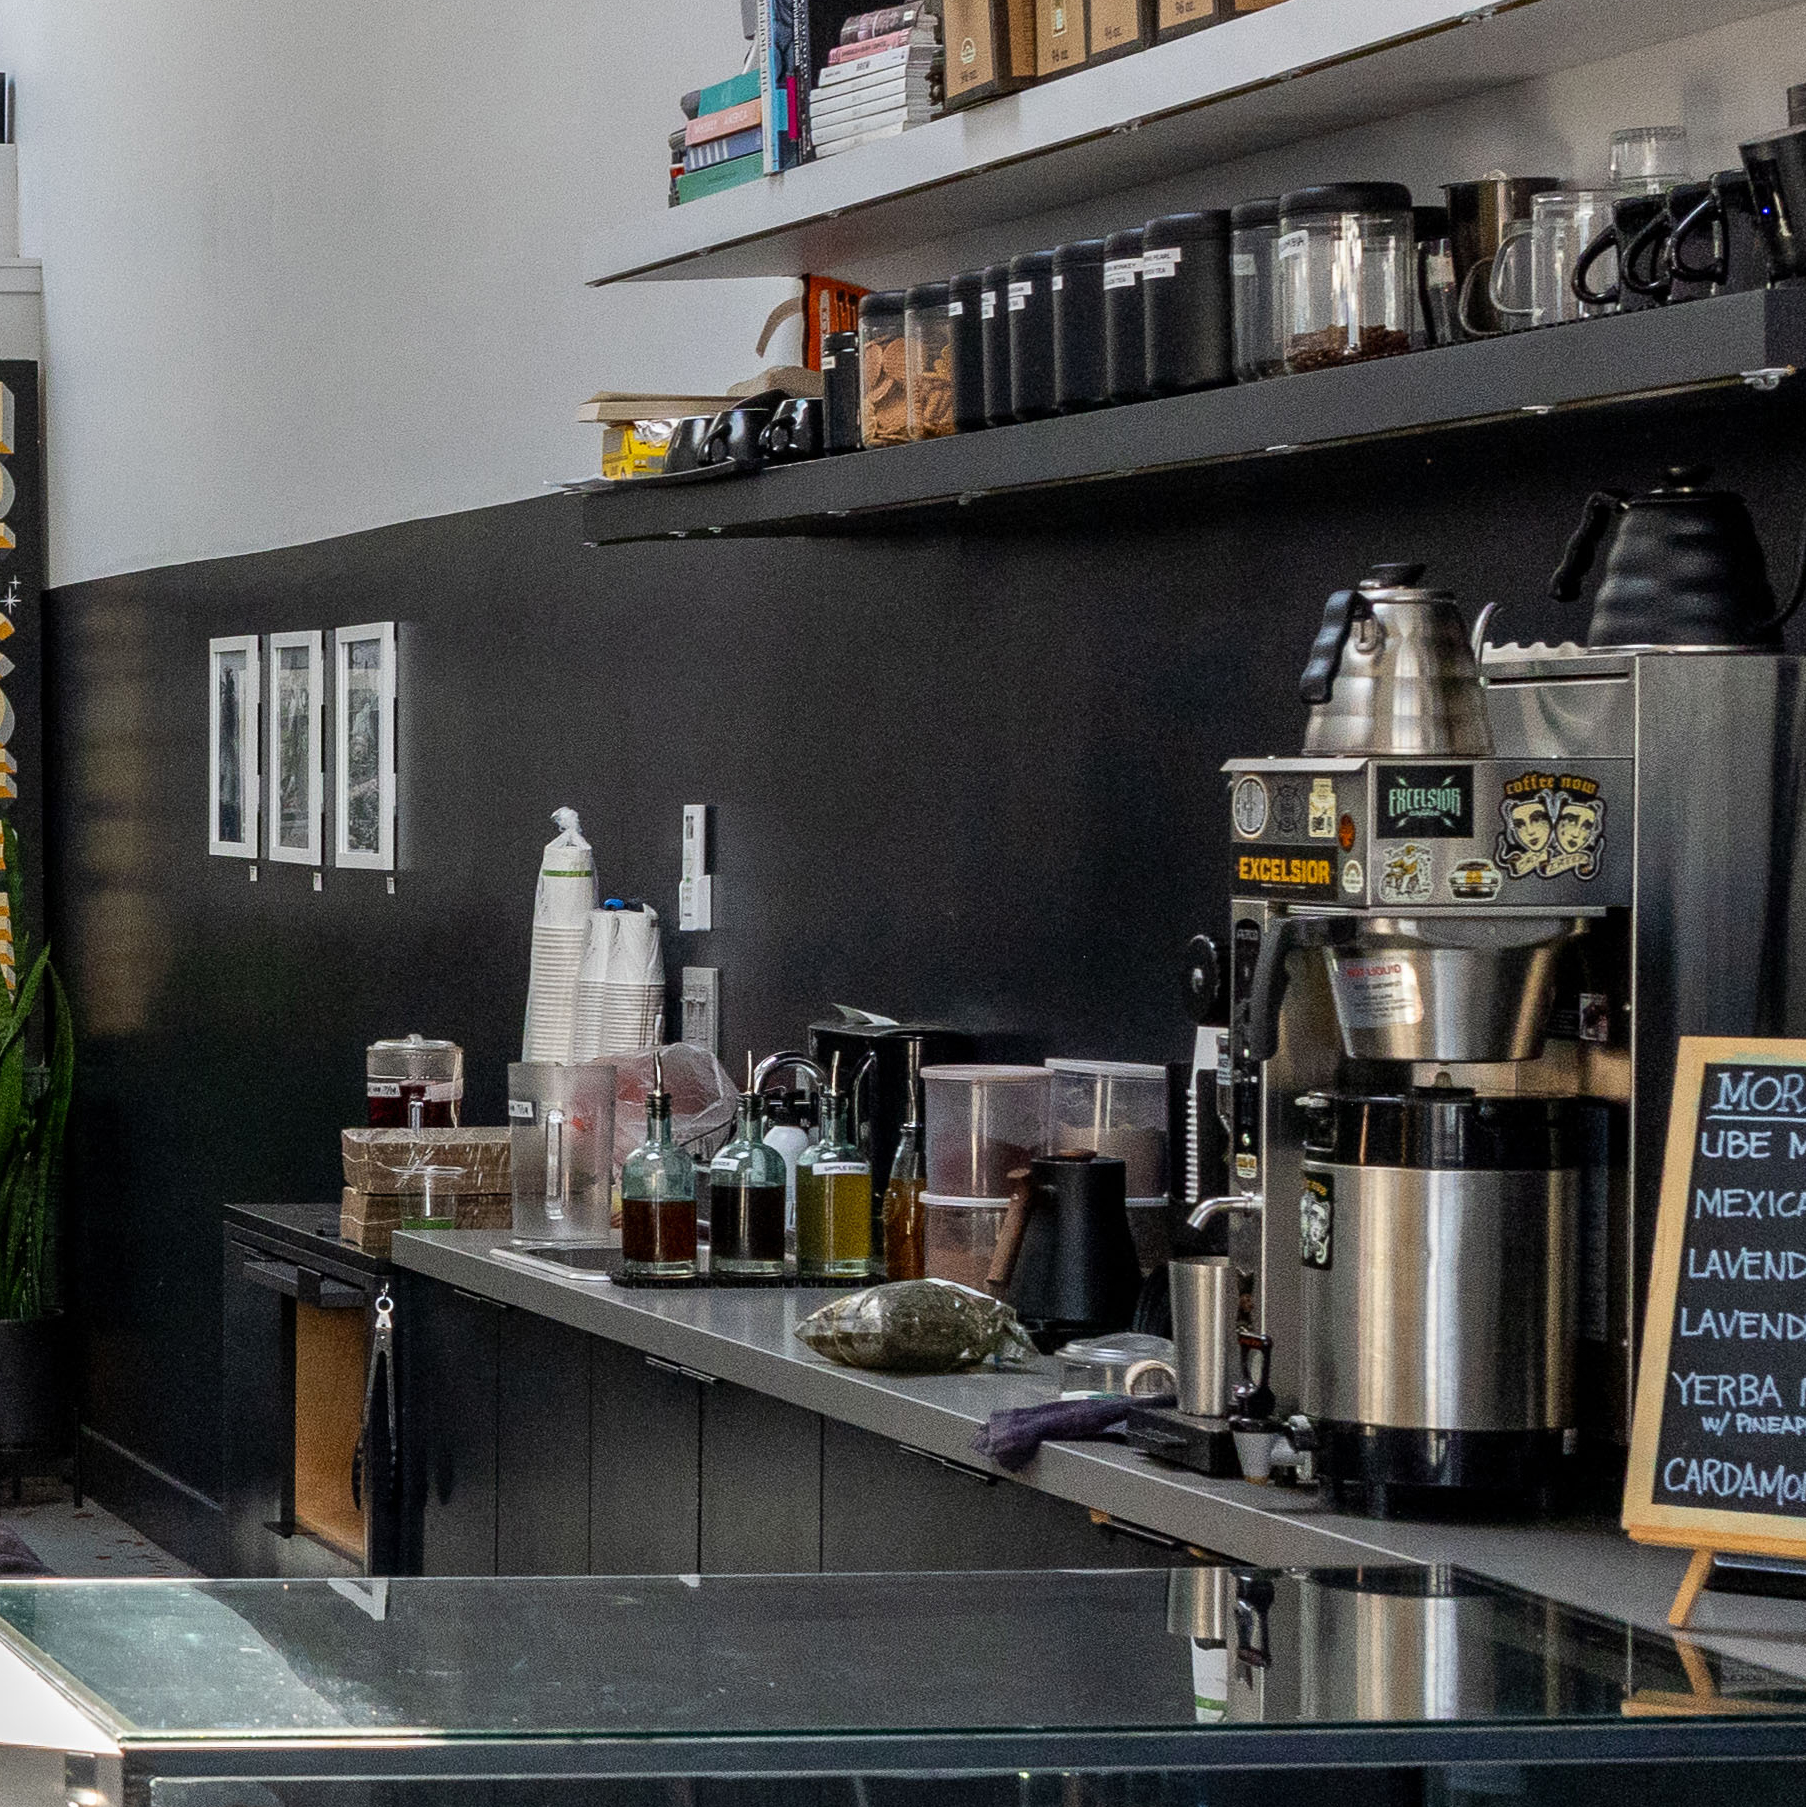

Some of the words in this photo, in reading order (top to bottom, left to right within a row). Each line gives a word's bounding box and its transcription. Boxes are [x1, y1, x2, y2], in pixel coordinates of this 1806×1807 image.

[1506, 773, 1555, 796] coffee
[1559, 777, 1598, 794] now
[1388, 786, 1462, 818] EXCELSIOR
[1239, 856, 1331, 885] EXCELSIOR
[1701, 1130, 1773, 1160] UBE
[1671, 1371, 1782, 1407] YERBA
[1700, 1410, 1732, 1437] w/
[1663, 1456, 1806, 1506] CARDAMO
